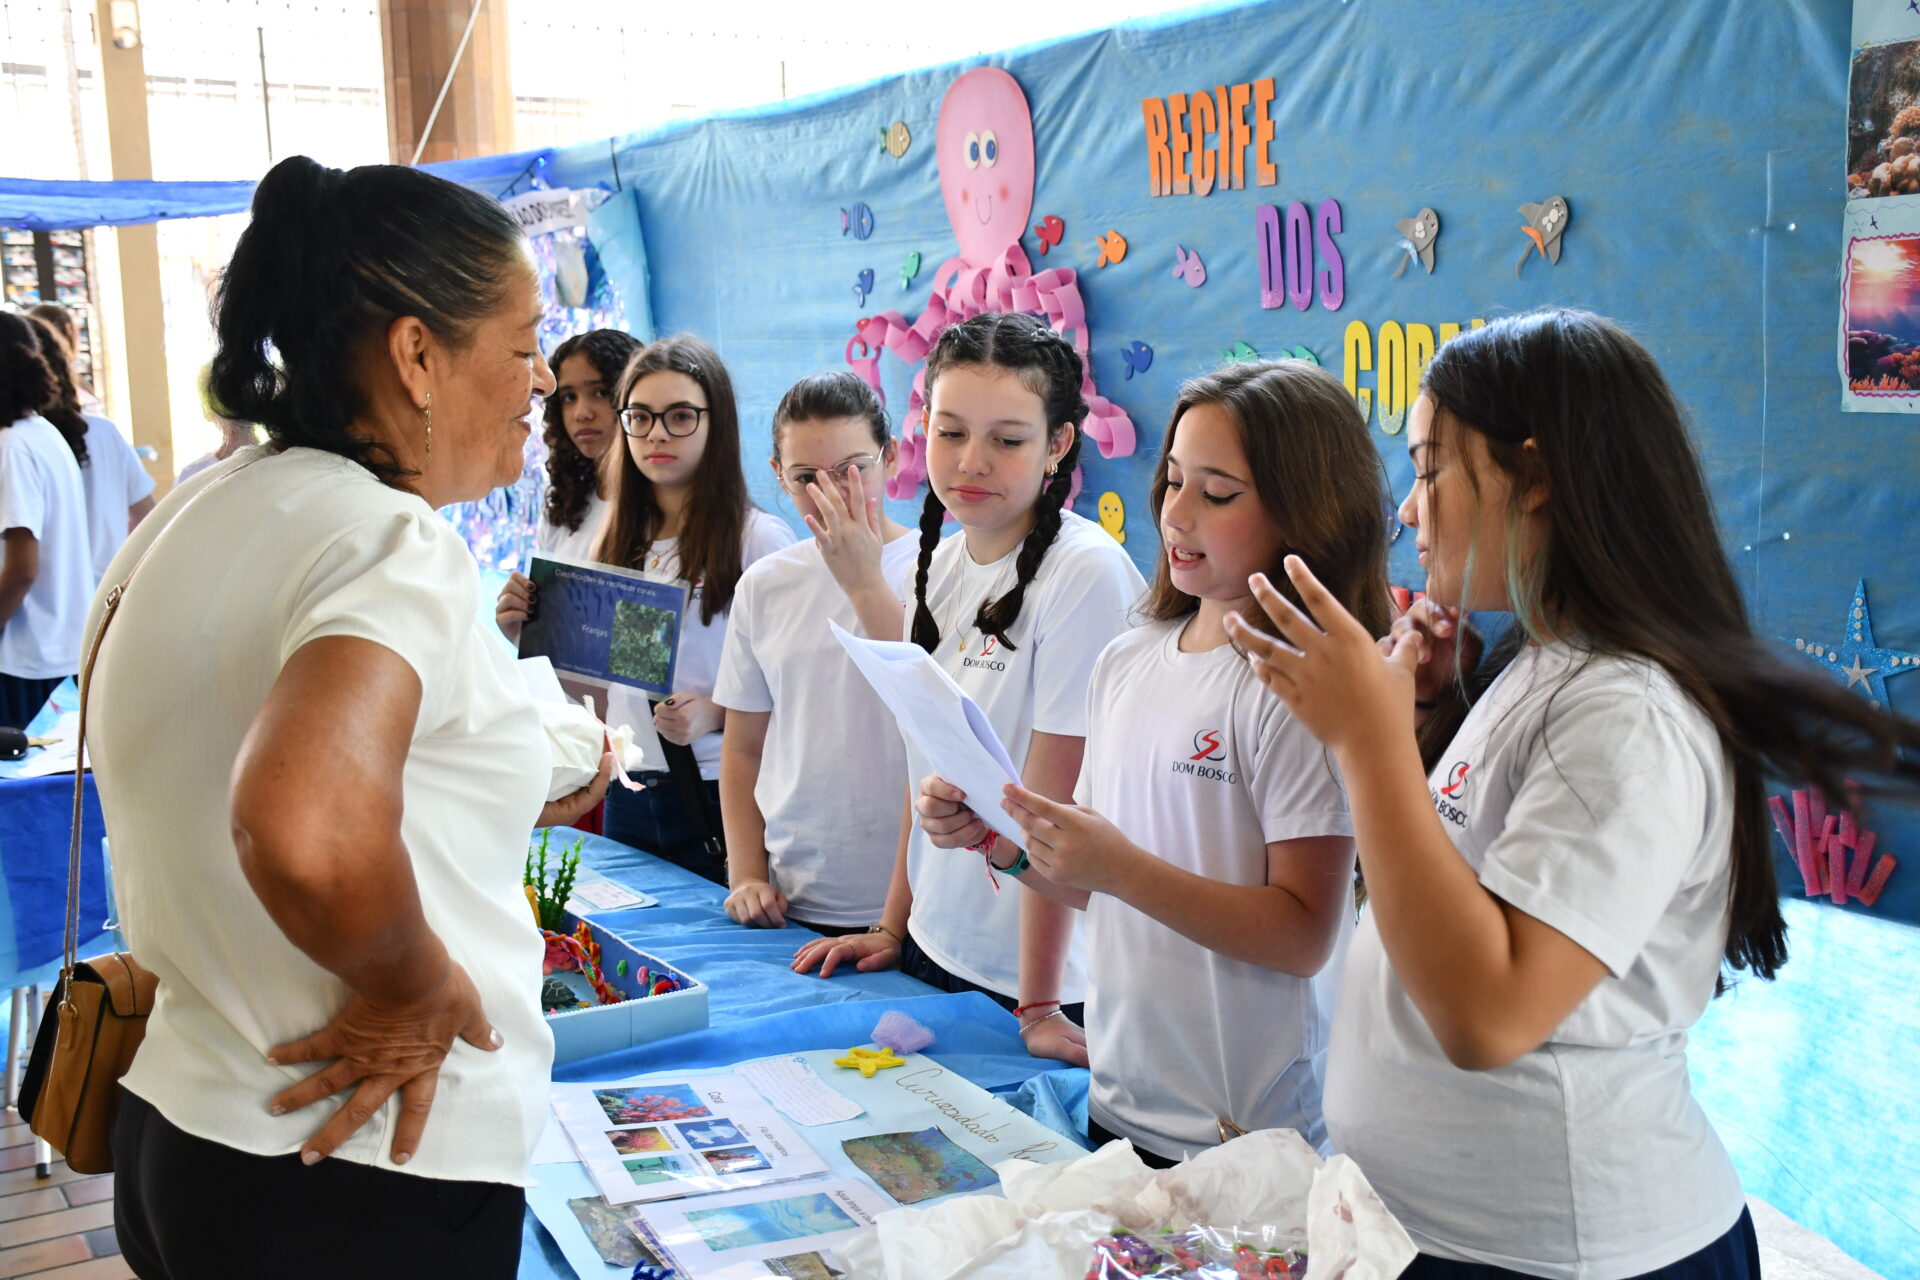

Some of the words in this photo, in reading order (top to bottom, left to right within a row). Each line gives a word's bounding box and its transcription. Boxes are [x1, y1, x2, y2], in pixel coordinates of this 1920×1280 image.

[1142, 78, 1277, 197] RECIFE
[1256, 199, 1345, 312] DOS
[1344, 320, 1486, 435] COR
[1172, 760, 1195, 775] DOM
[1197, 765, 1237, 785] BOSCO
